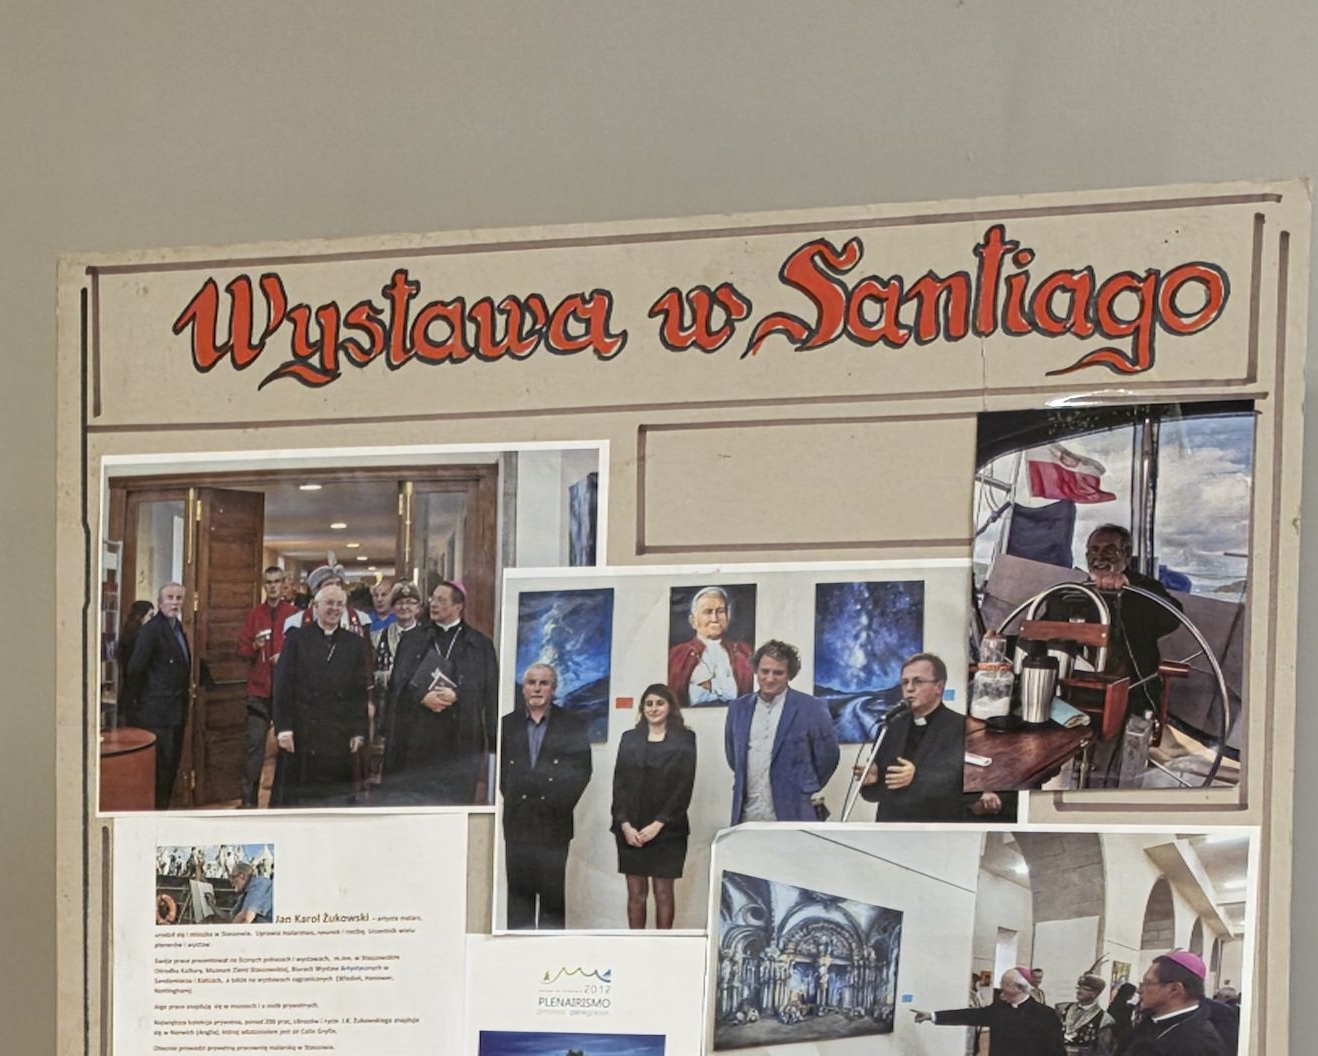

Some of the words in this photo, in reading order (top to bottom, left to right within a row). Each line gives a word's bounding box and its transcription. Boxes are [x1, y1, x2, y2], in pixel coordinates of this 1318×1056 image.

[175, 270, 626, 388] Wystawa
[650, 283, 751, 355] w
[742, 223, 1230, 379] Santiago
[276, 914, 292, 924] Jan
[294, 914, 320, 924] Karol
[322, 912, 370, 923] Żukowski
[584, 984, 611, 994] 2012
[538, 996, 611, 1008] PLENAIRISMO
